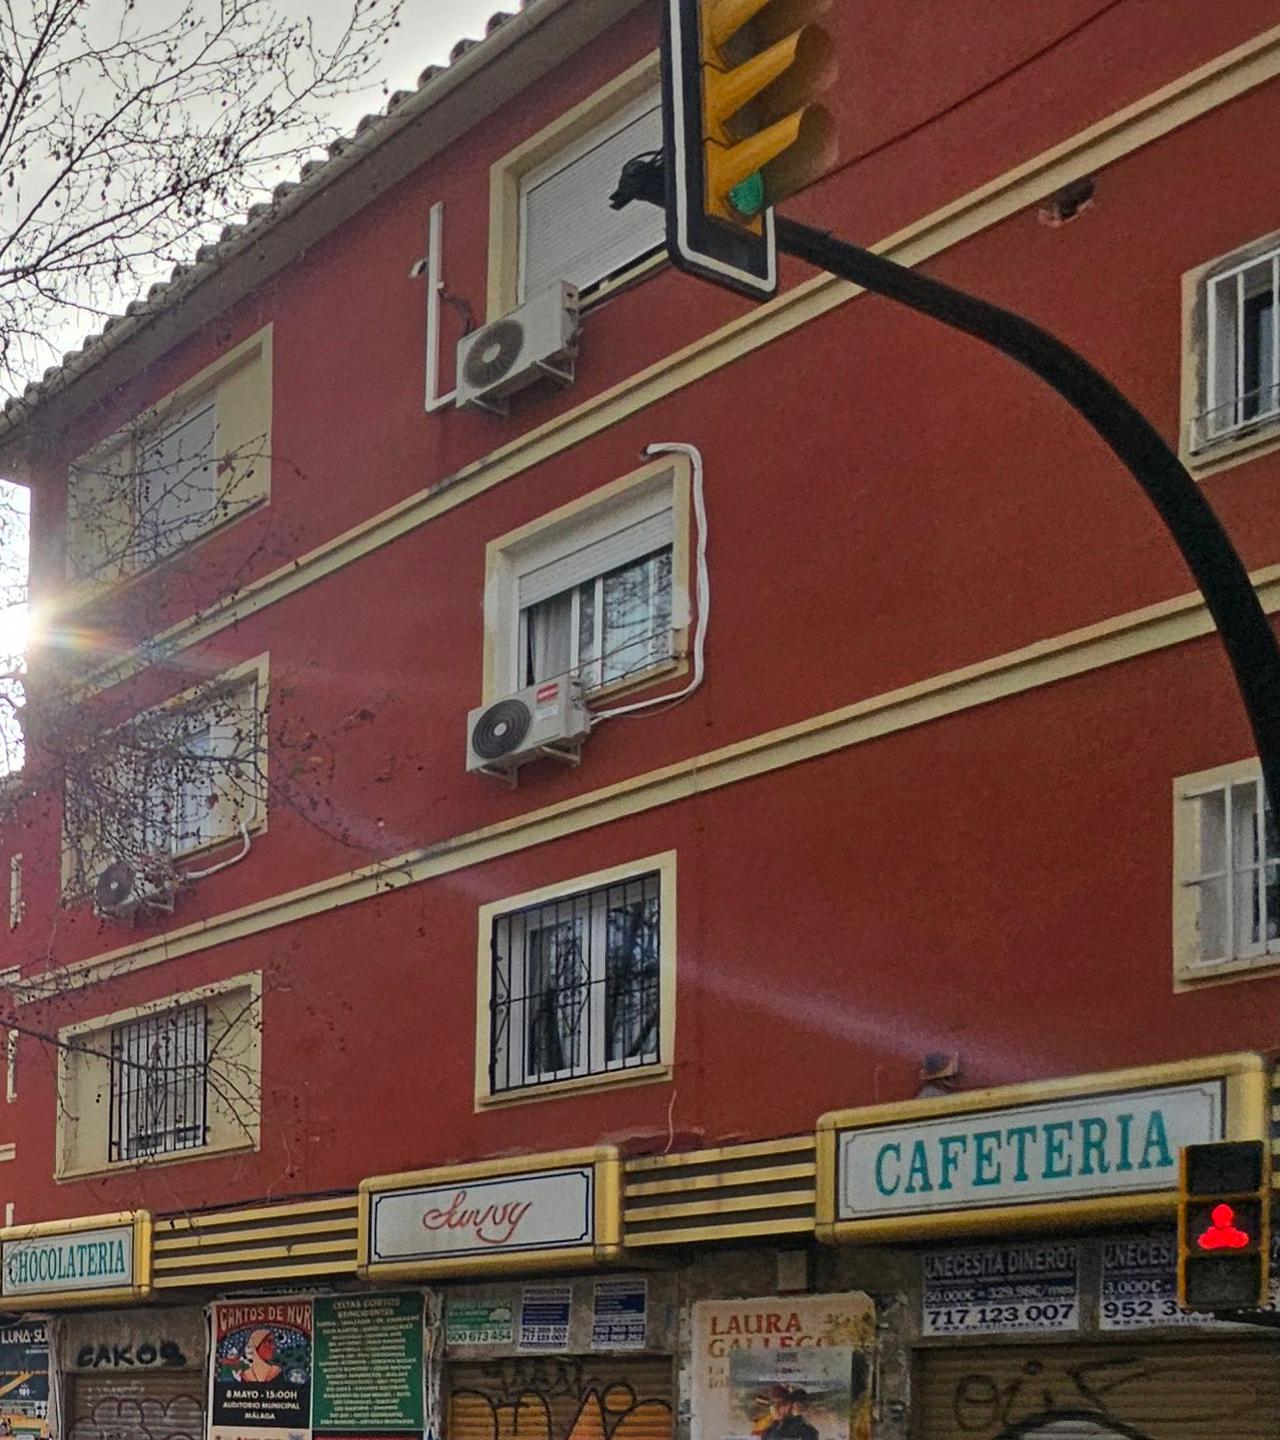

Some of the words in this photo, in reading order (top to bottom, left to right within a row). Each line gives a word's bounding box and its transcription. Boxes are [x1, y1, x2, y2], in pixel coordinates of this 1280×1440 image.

[874, 1108, 1175, 1197] CAFETERIA
[8, 1239, 126, 1284] CHOCOLATERIA
[1007, 1247, 1076, 1273] DINERO?
[219, 1307, 265, 1331] CANTOS
[268, 1305, 285, 1320] DE
[286, 1304, 312, 1331] NUR
[928, 1309, 970, 1326] 717
[978, 1306, 1019, 1324] 123
[1025, 1303, 1075, 1322] 007
[1103, 1300, 1153, 1319] 952
[710, 1312, 803, 1337] LAURA
[232, 1389, 258, 1399] MAYO
[262, 1401, 300, 1409] MUNICIPAL
